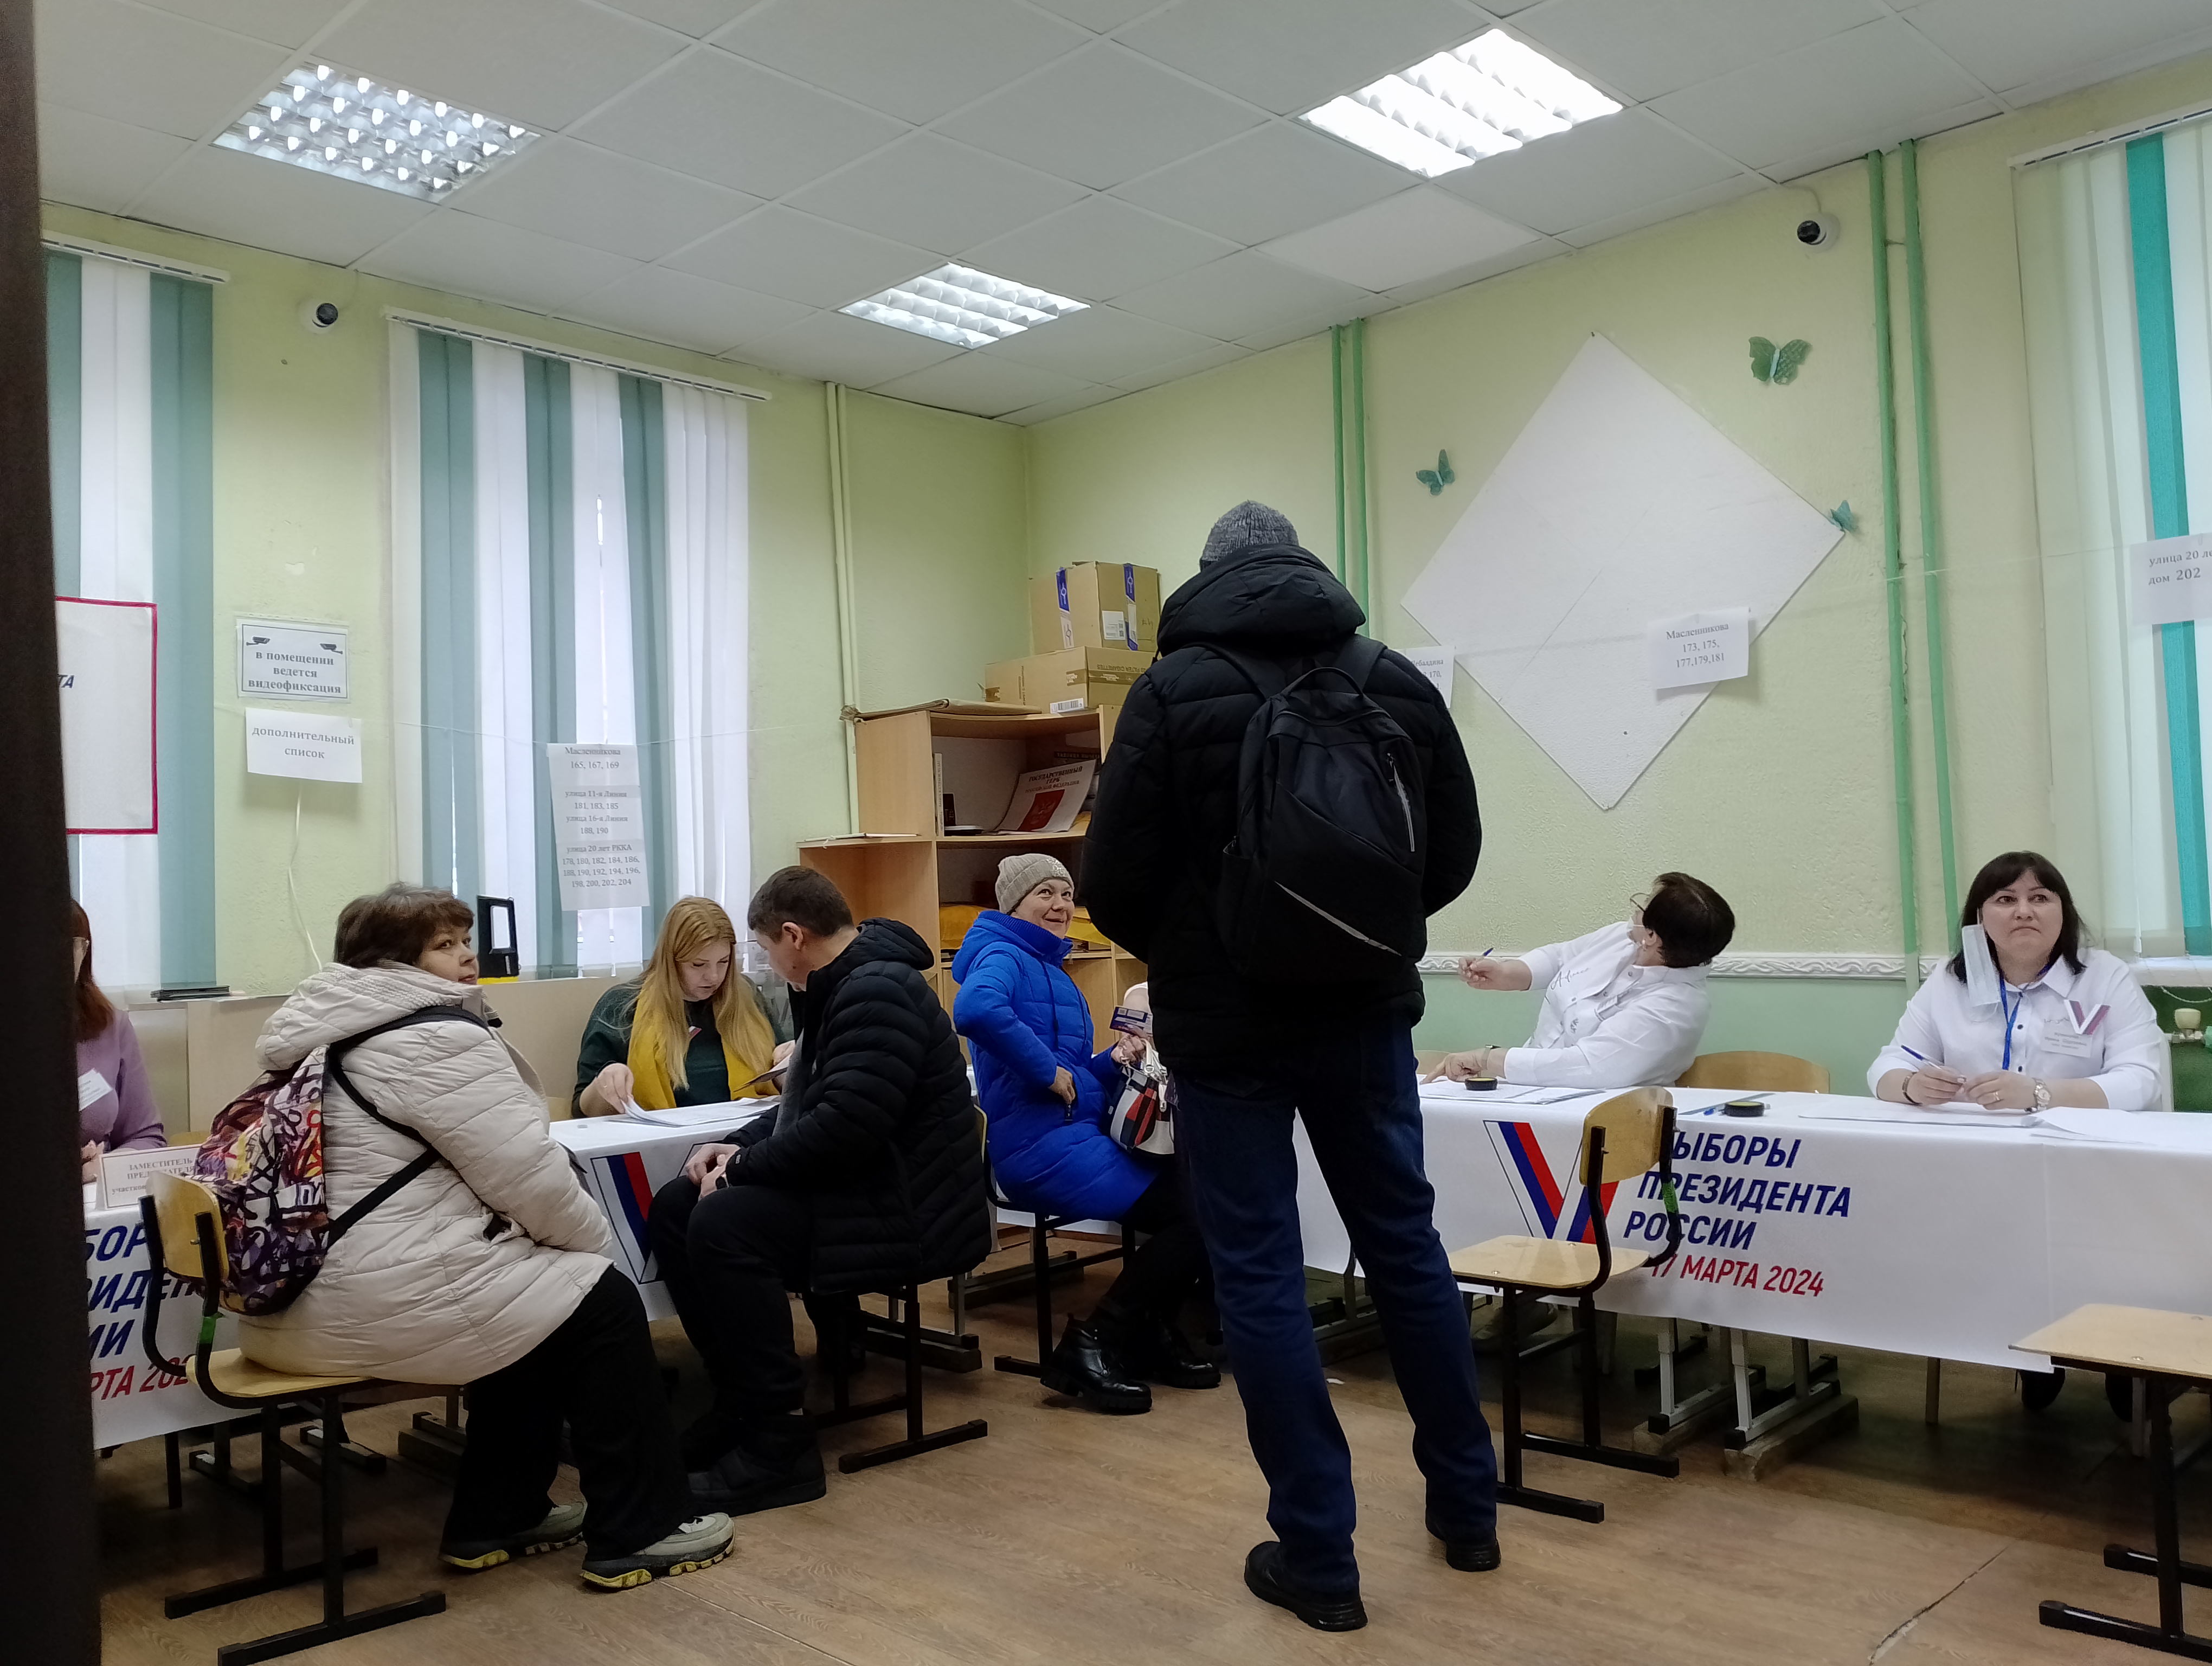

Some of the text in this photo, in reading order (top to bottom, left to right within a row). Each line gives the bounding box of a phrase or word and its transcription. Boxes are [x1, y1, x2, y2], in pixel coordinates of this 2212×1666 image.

[2149, 554, 2182, 567] улица
[2185, 550, 2199, 560] 20
[2149, 567, 2201, 586] дом 202
[1666, 624, 1729, 639] Масленникова
[1683, 639, 1720, 652] 173, 175,
[266, 652, 334, 665] помещении
[1676, 652, 1725, 668] 177,179,181
[273, 667, 317, 678] ведется
[59, 674, 75, 689] ТА
[248, 680, 342, 694] видеофиксация
[252, 727, 355, 745] дополнительный
[285, 748, 325, 759] список
[565, 747, 621, 755] Масленникова
[571, 761, 620, 769] 165, 167, 169
[1672, 1131, 1803, 1169] ЫБОРЫ
[112, 1183, 146, 1195] участков
[1680, 1254, 1759, 1289] МАРТА
[1763, 1265, 1825, 1297] 2024
